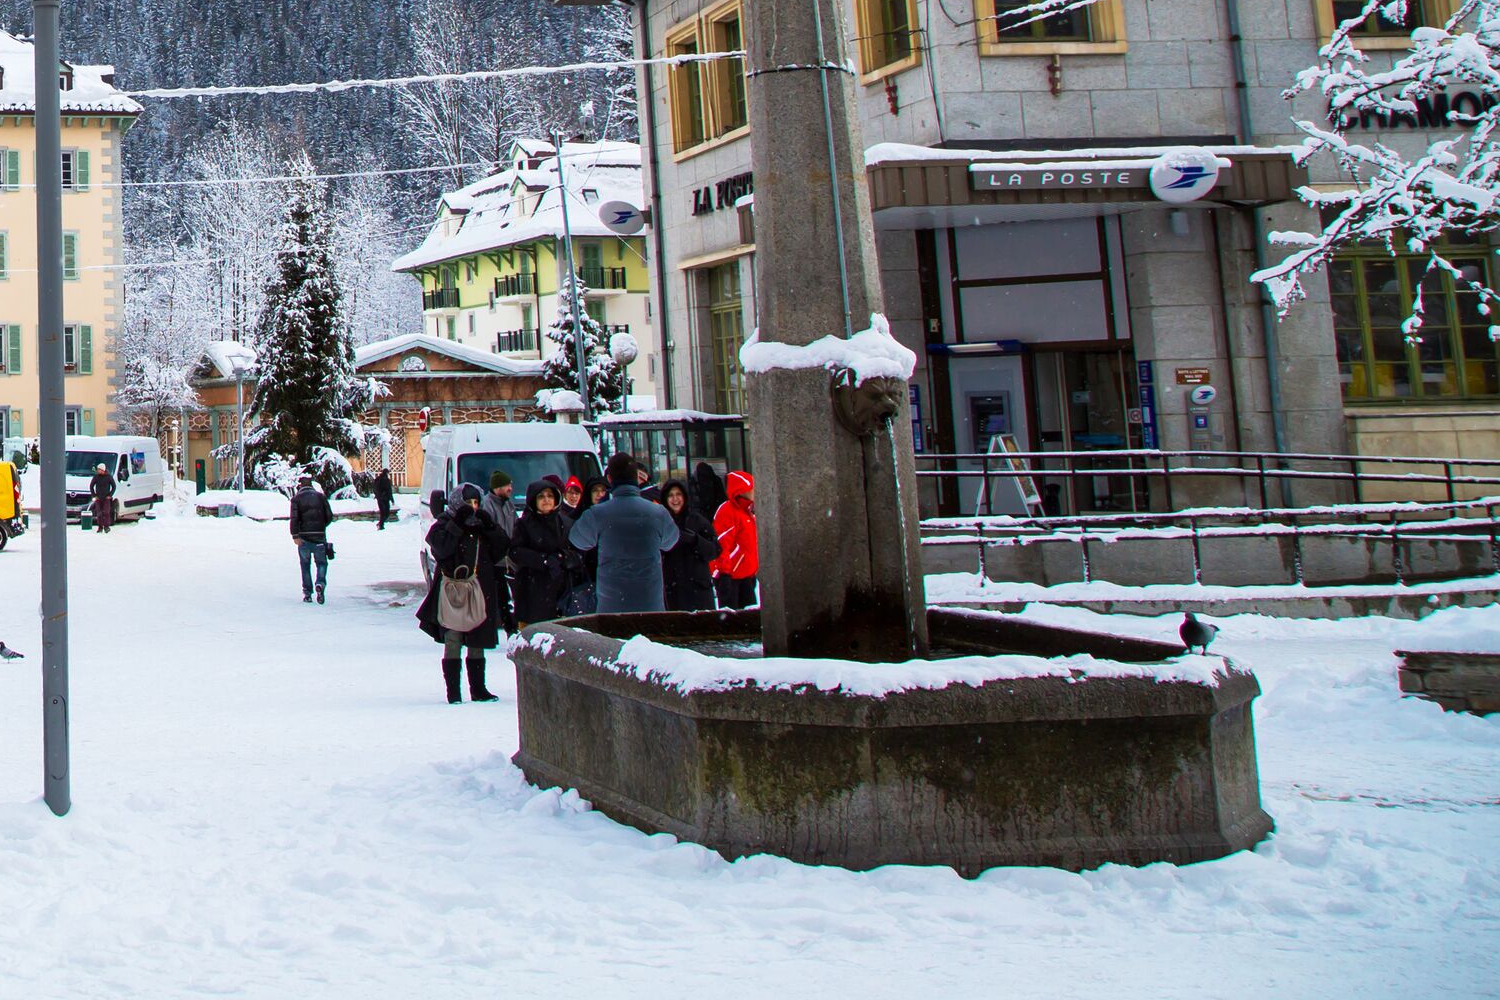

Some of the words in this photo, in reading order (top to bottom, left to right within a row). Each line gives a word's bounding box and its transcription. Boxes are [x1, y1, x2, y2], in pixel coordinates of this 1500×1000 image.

[989, 173, 1022, 186] LA
[1041, 172, 1131, 185] POSTE
[692, 186, 714, 216] LA
